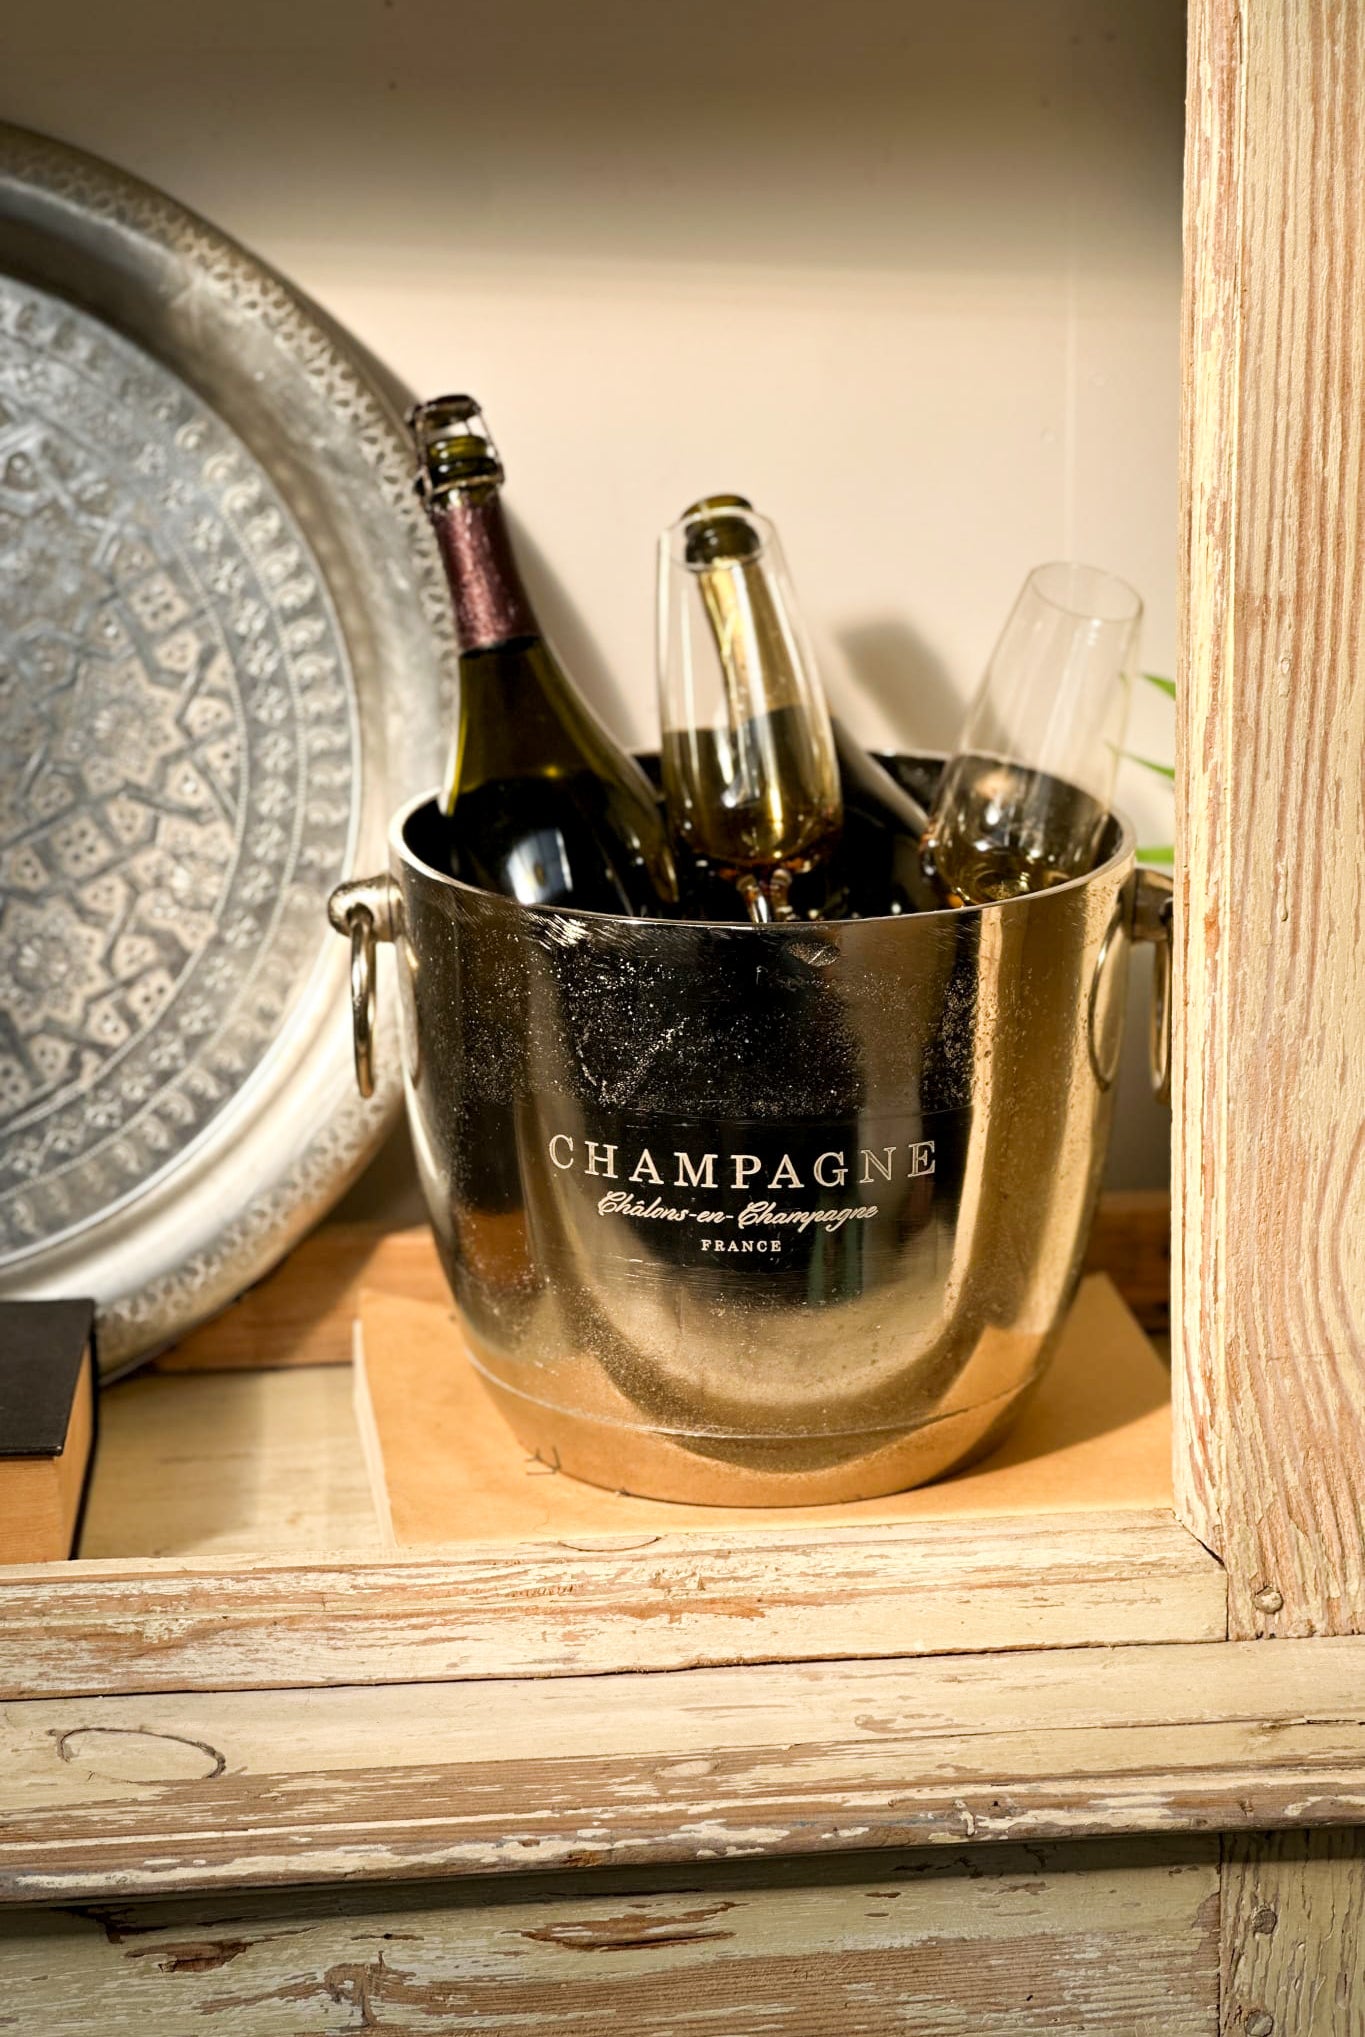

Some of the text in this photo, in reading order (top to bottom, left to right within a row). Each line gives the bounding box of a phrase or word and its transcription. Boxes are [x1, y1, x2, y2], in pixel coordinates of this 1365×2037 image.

[548, 1133, 936, 1189] CHAMPAGNE
[597, 1190, 879, 1233] Châlons-en-Champagne
[700, 1238, 782, 1252] FRANCE
